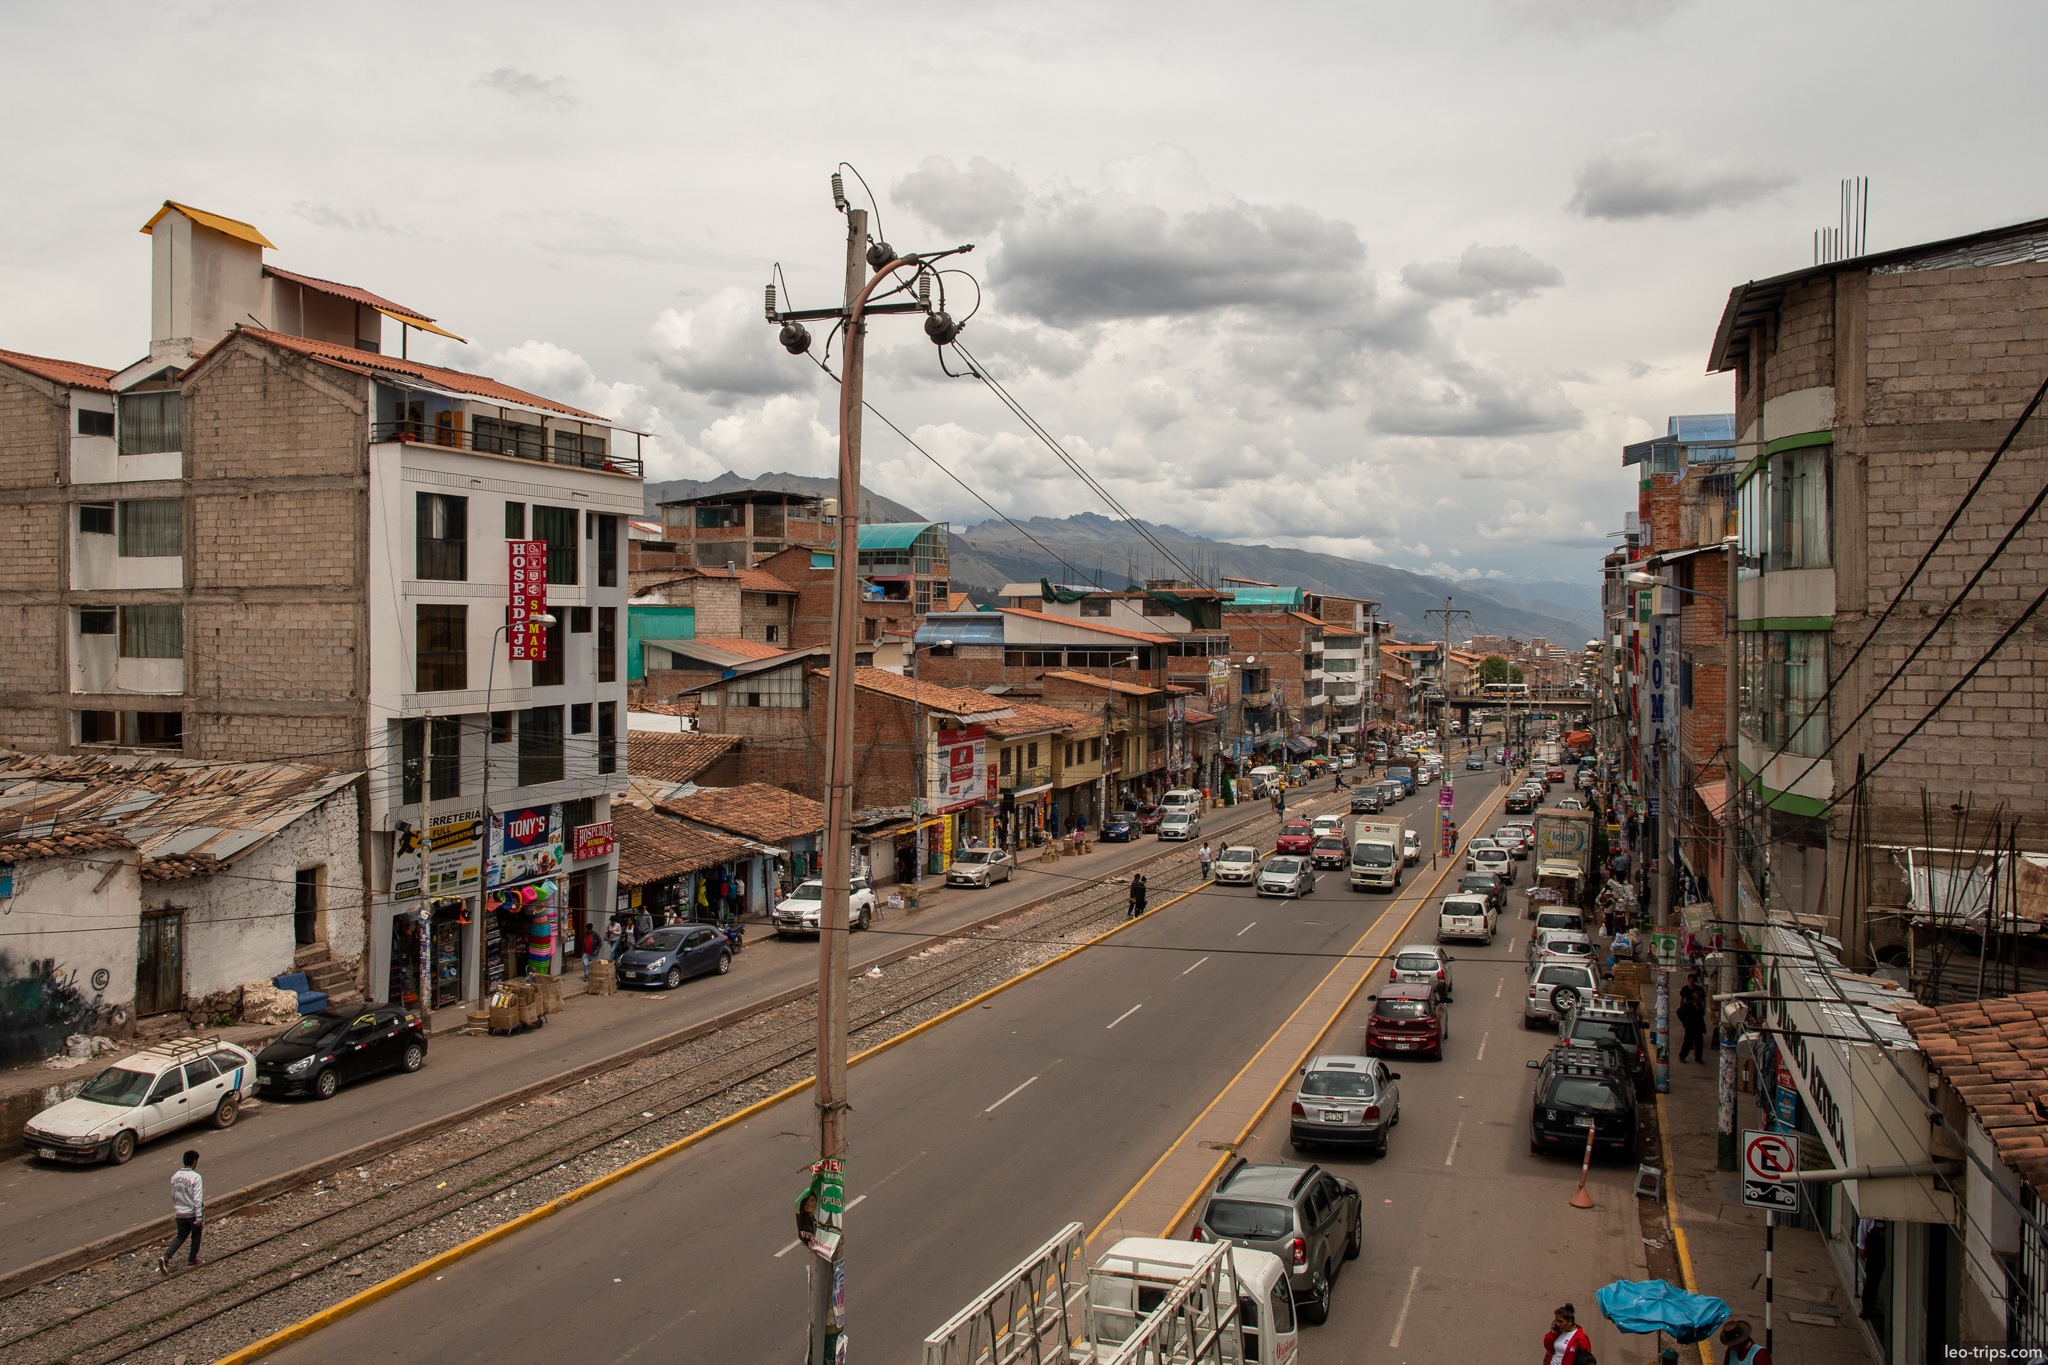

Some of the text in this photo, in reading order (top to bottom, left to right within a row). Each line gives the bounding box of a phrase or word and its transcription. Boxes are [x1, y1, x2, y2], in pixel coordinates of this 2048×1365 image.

[512, 543, 526, 658] HOSPEDAJE
[432, 826, 452, 838] FULL
[509, 815, 546, 839] TONY'S
[579, 823, 614, 848] HOSPEDAJE
[1553, 830, 1576, 842] Ideal
[587, 837, 606, 847] SUMAC
[396, 889, 420, 899] KAMASA
[1761, 1143, 1781, 1172] E
[823, 1196, 842, 1208] FIA
